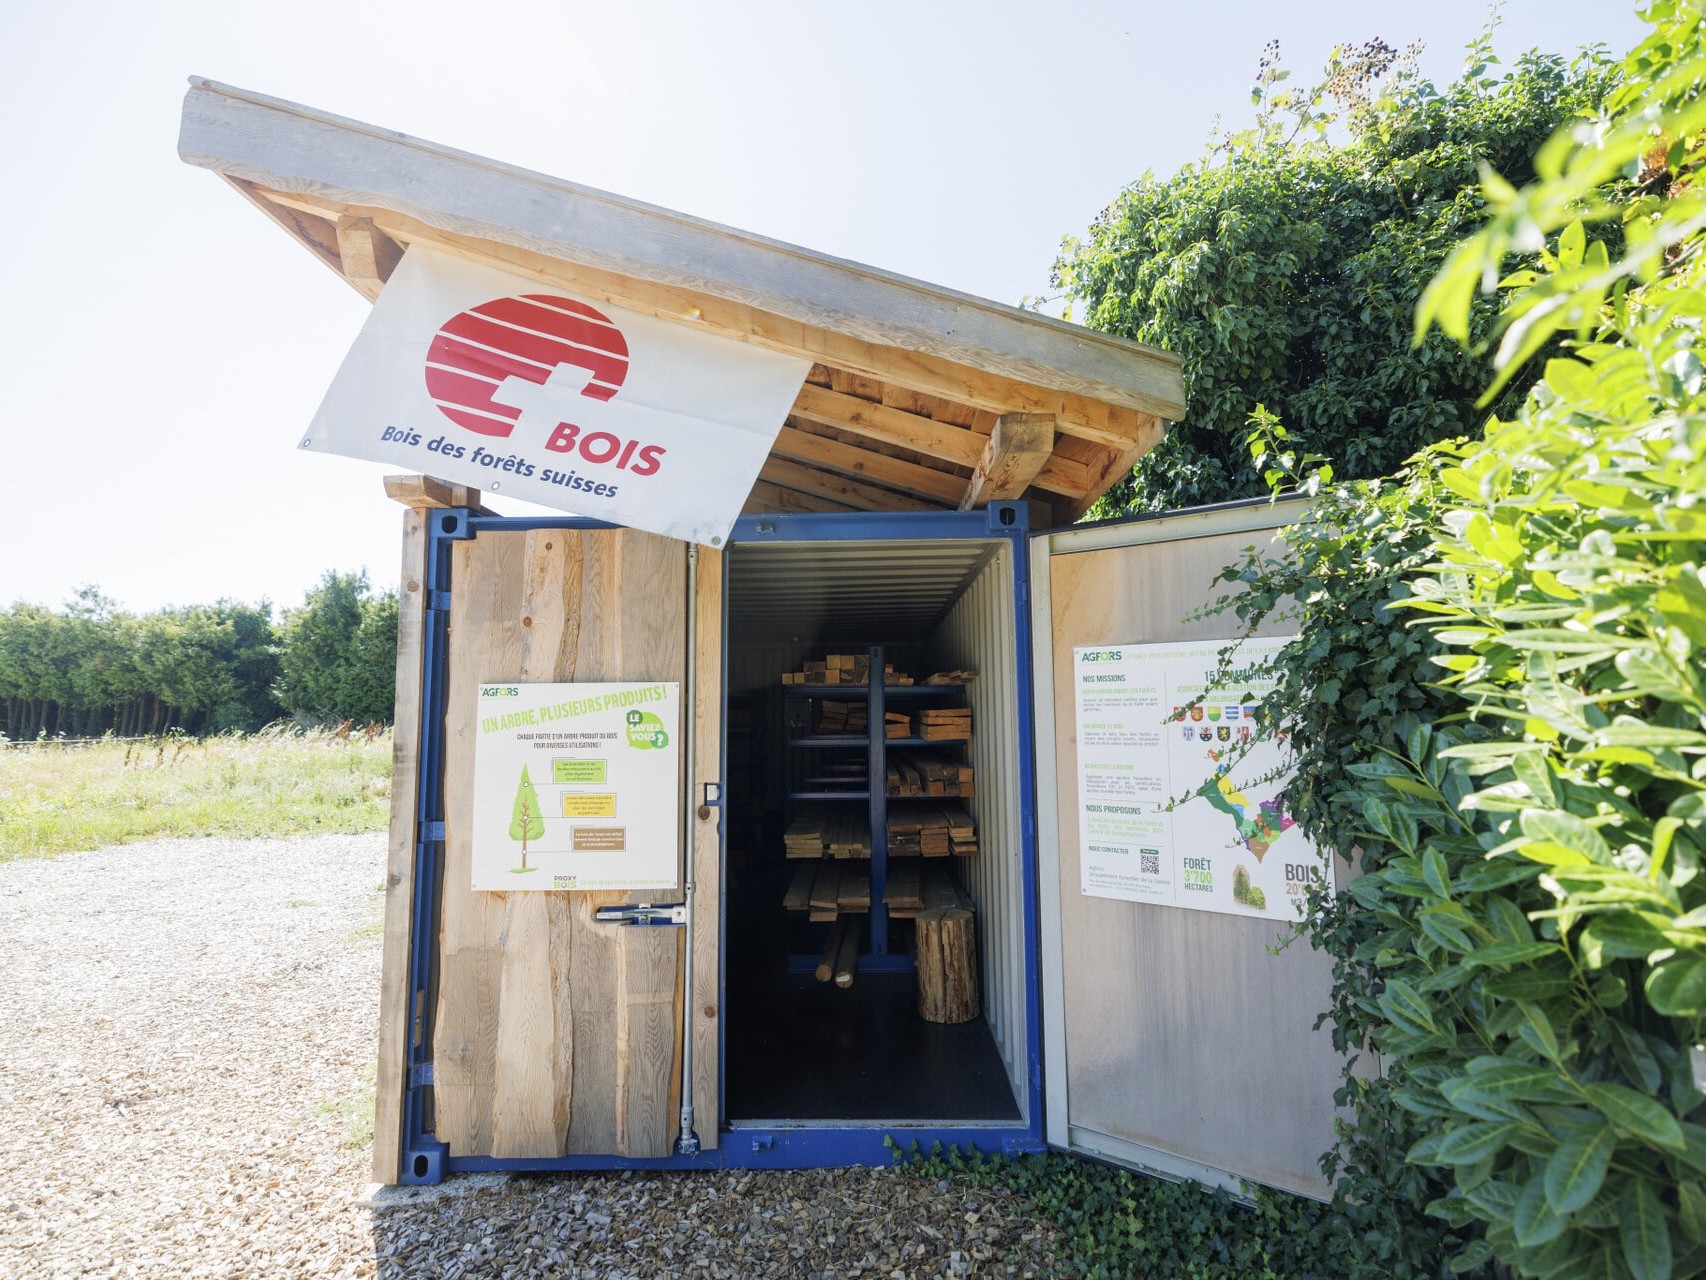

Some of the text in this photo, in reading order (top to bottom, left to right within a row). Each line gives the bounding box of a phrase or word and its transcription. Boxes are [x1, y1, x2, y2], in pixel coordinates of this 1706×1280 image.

[545, 421, 667, 476] BOIS
[381, 426, 618, 497] Bois des forêts suisses
[1082, 651, 1122, 662] AGFORS
[1097, 674, 1126, 682] MISSIONS
[1205, 670, 1215, 681] 15
[482, 687, 518, 697] AGFORS
[482, 717, 498, 733] UN
[500, 708, 539, 730] ARBRE,
[541, 698, 602, 723] PLUSIEURS
[604, 688, 660, 710] PRODUITS
[630, 714, 640, 722] LE
[631, 733, 656, 741] VOUS
[1086, 804, 1141, 815] NOUS PROPOSONS
[1183, 857, 1212, 871] FORÊT
[1184, 870, 1212, 884] 3'700
[554, 881, 577, 889] BOIS
[1184, 882, 1213, 892] HECTARES
